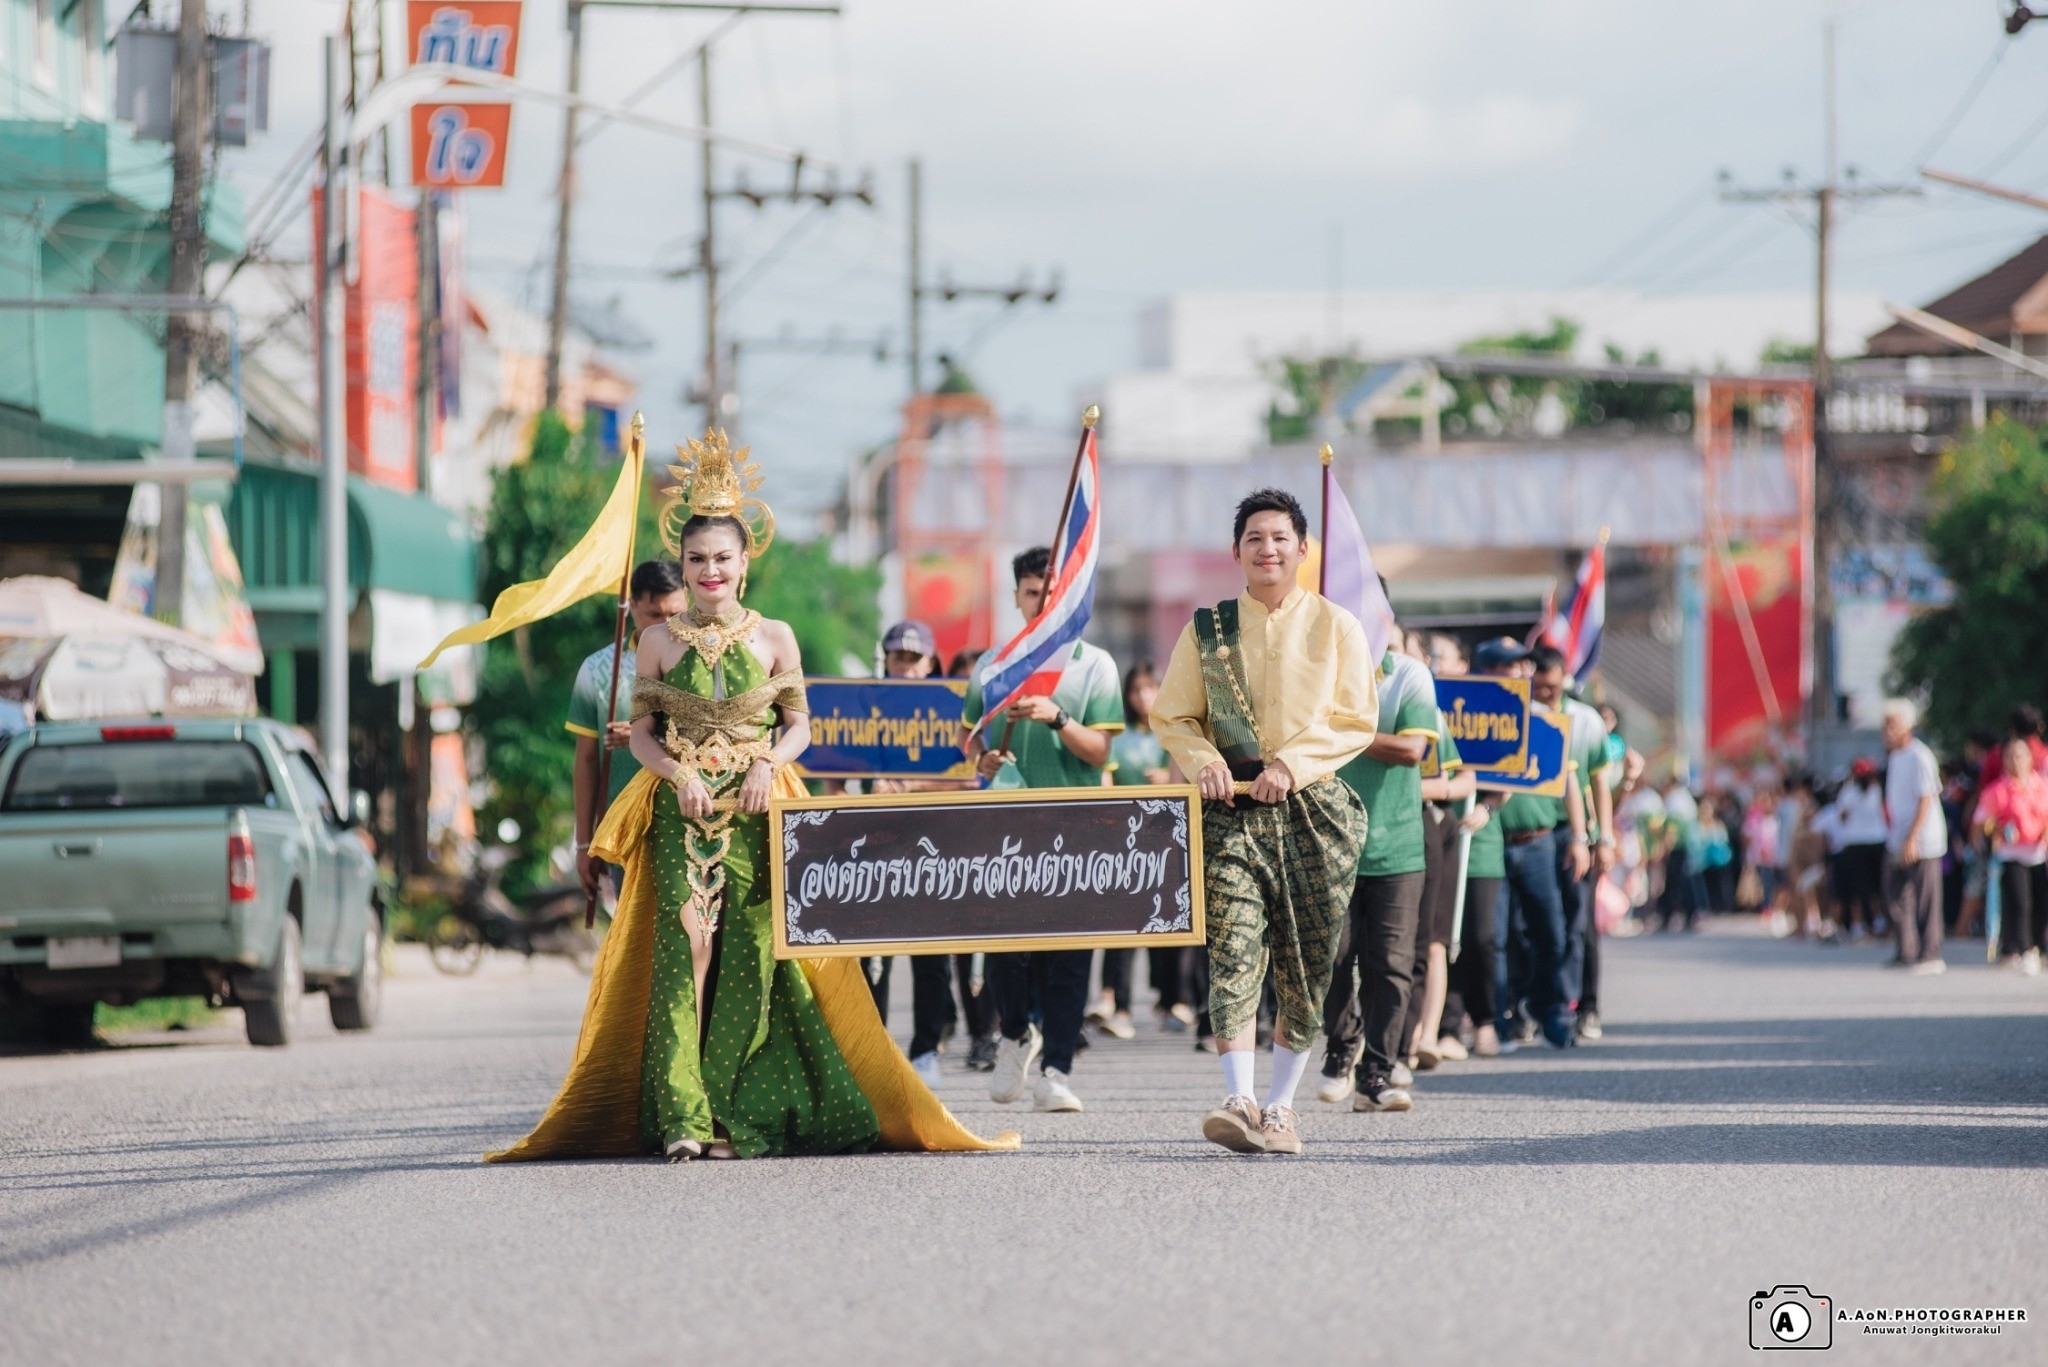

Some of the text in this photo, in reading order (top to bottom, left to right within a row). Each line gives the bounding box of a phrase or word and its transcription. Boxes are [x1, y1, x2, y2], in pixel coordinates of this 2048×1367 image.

[800, 811, 1173, 919] องค์การบริหารส่วนตำบลน้ำพุ
